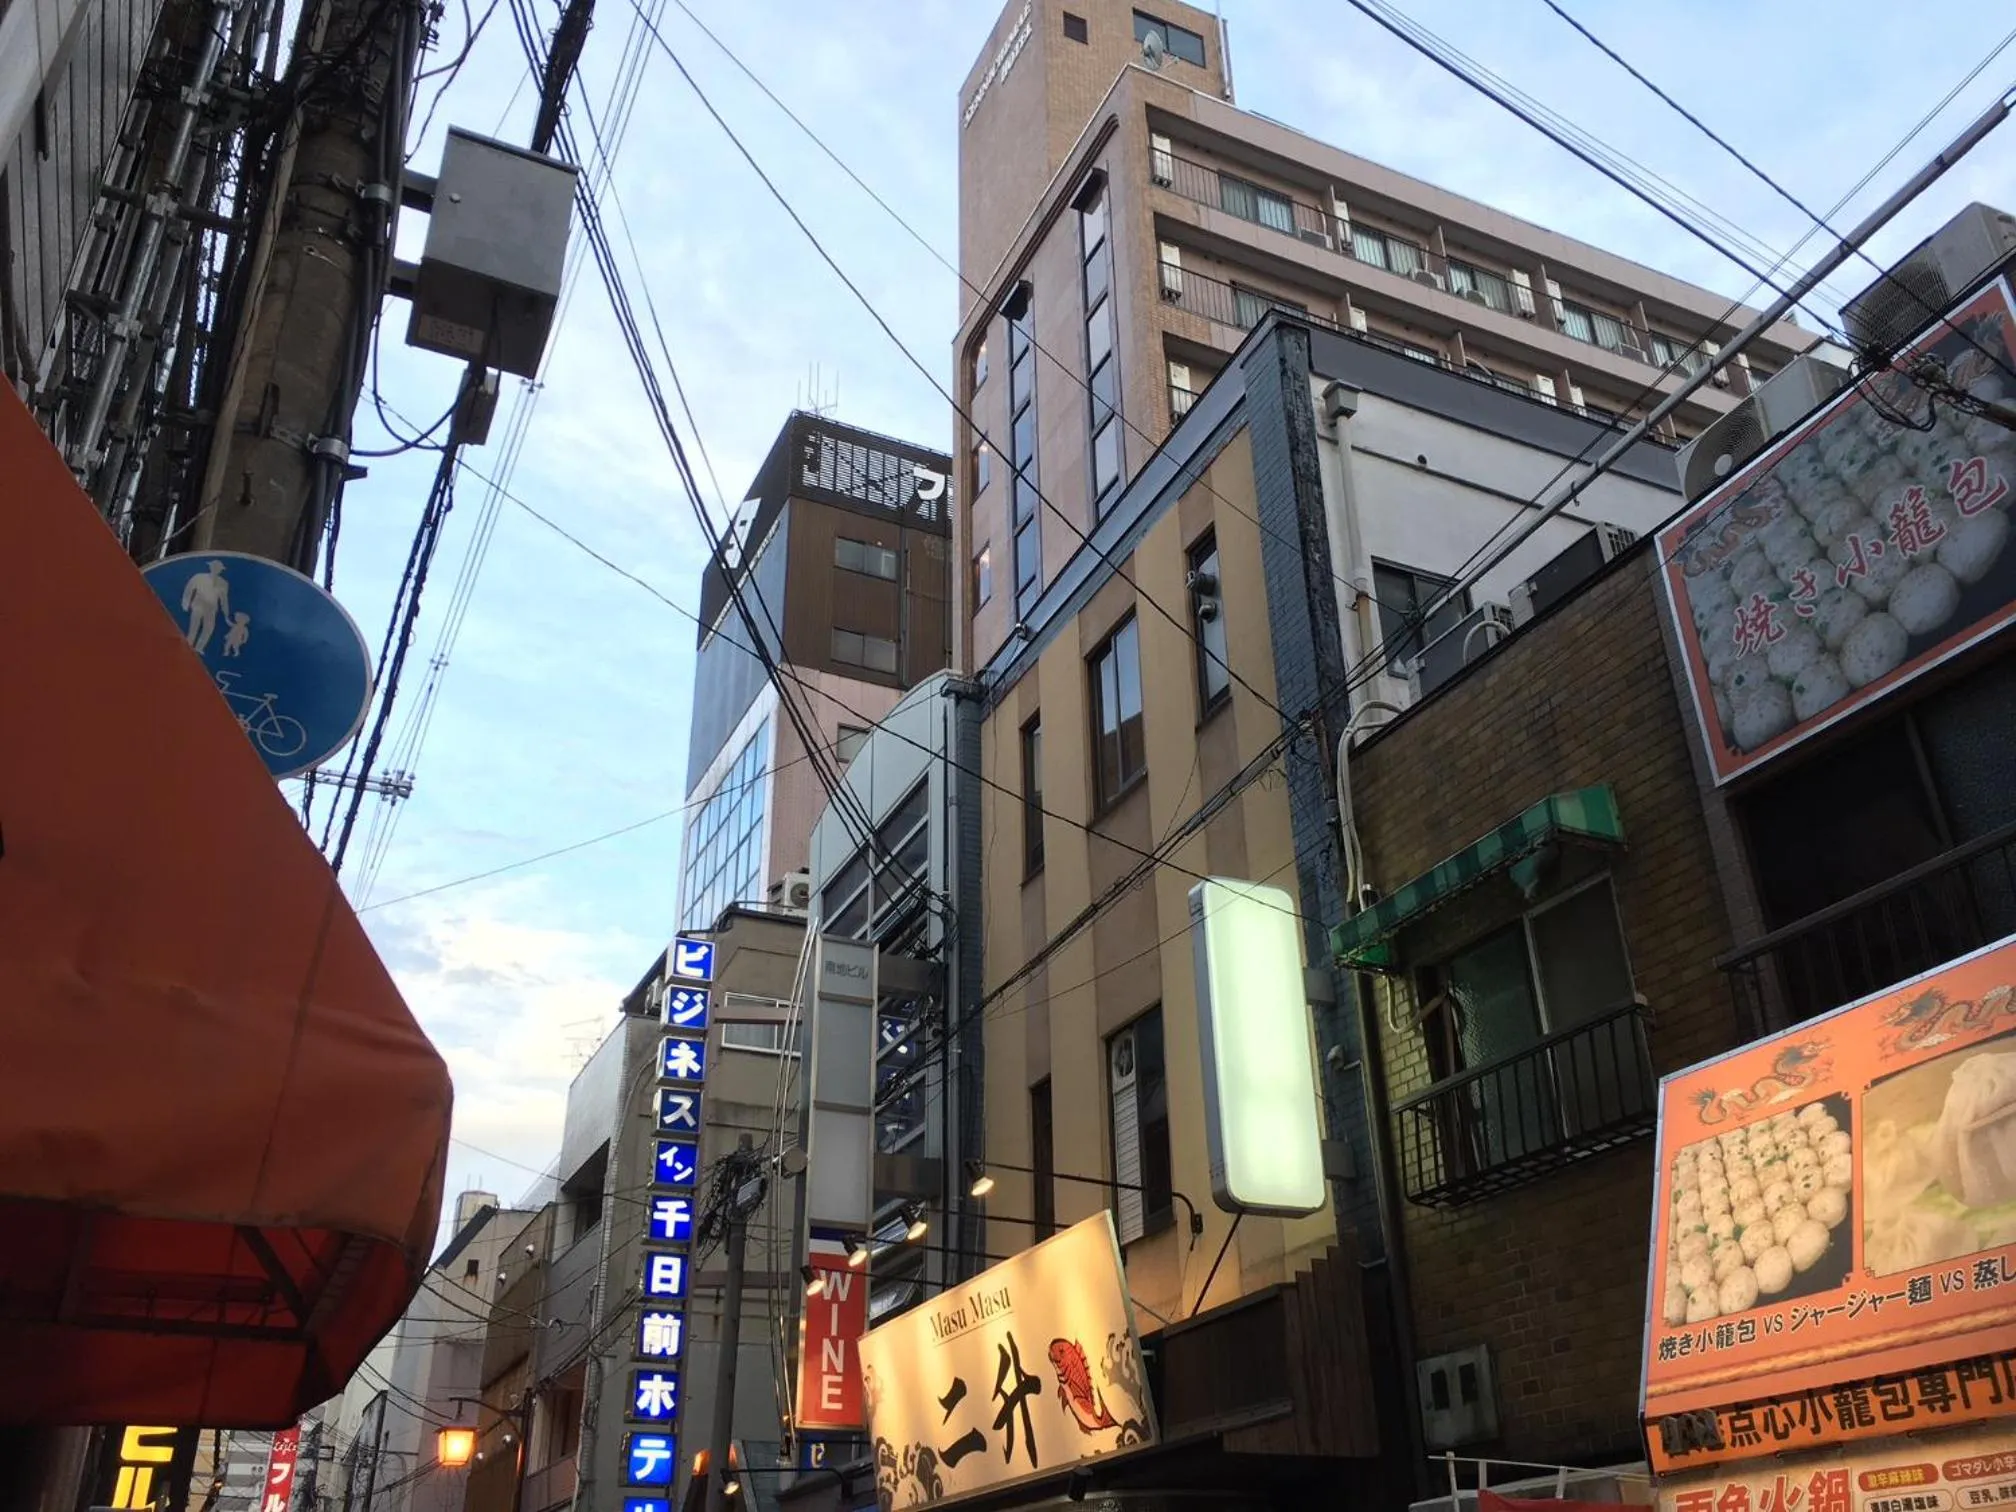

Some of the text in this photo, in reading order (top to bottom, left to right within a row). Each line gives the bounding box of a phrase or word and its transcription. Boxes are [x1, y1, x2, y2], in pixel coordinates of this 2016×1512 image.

[820, 1270, 854, 1410] WINE
[929, 1287, 1012, 1341] Masu Masu
[1657, 1318, 1756, 1361] 焼き小籠包
[1763, 1313, 1783, 1334] VS
[1940, 1270, 1964, 1293] VS
